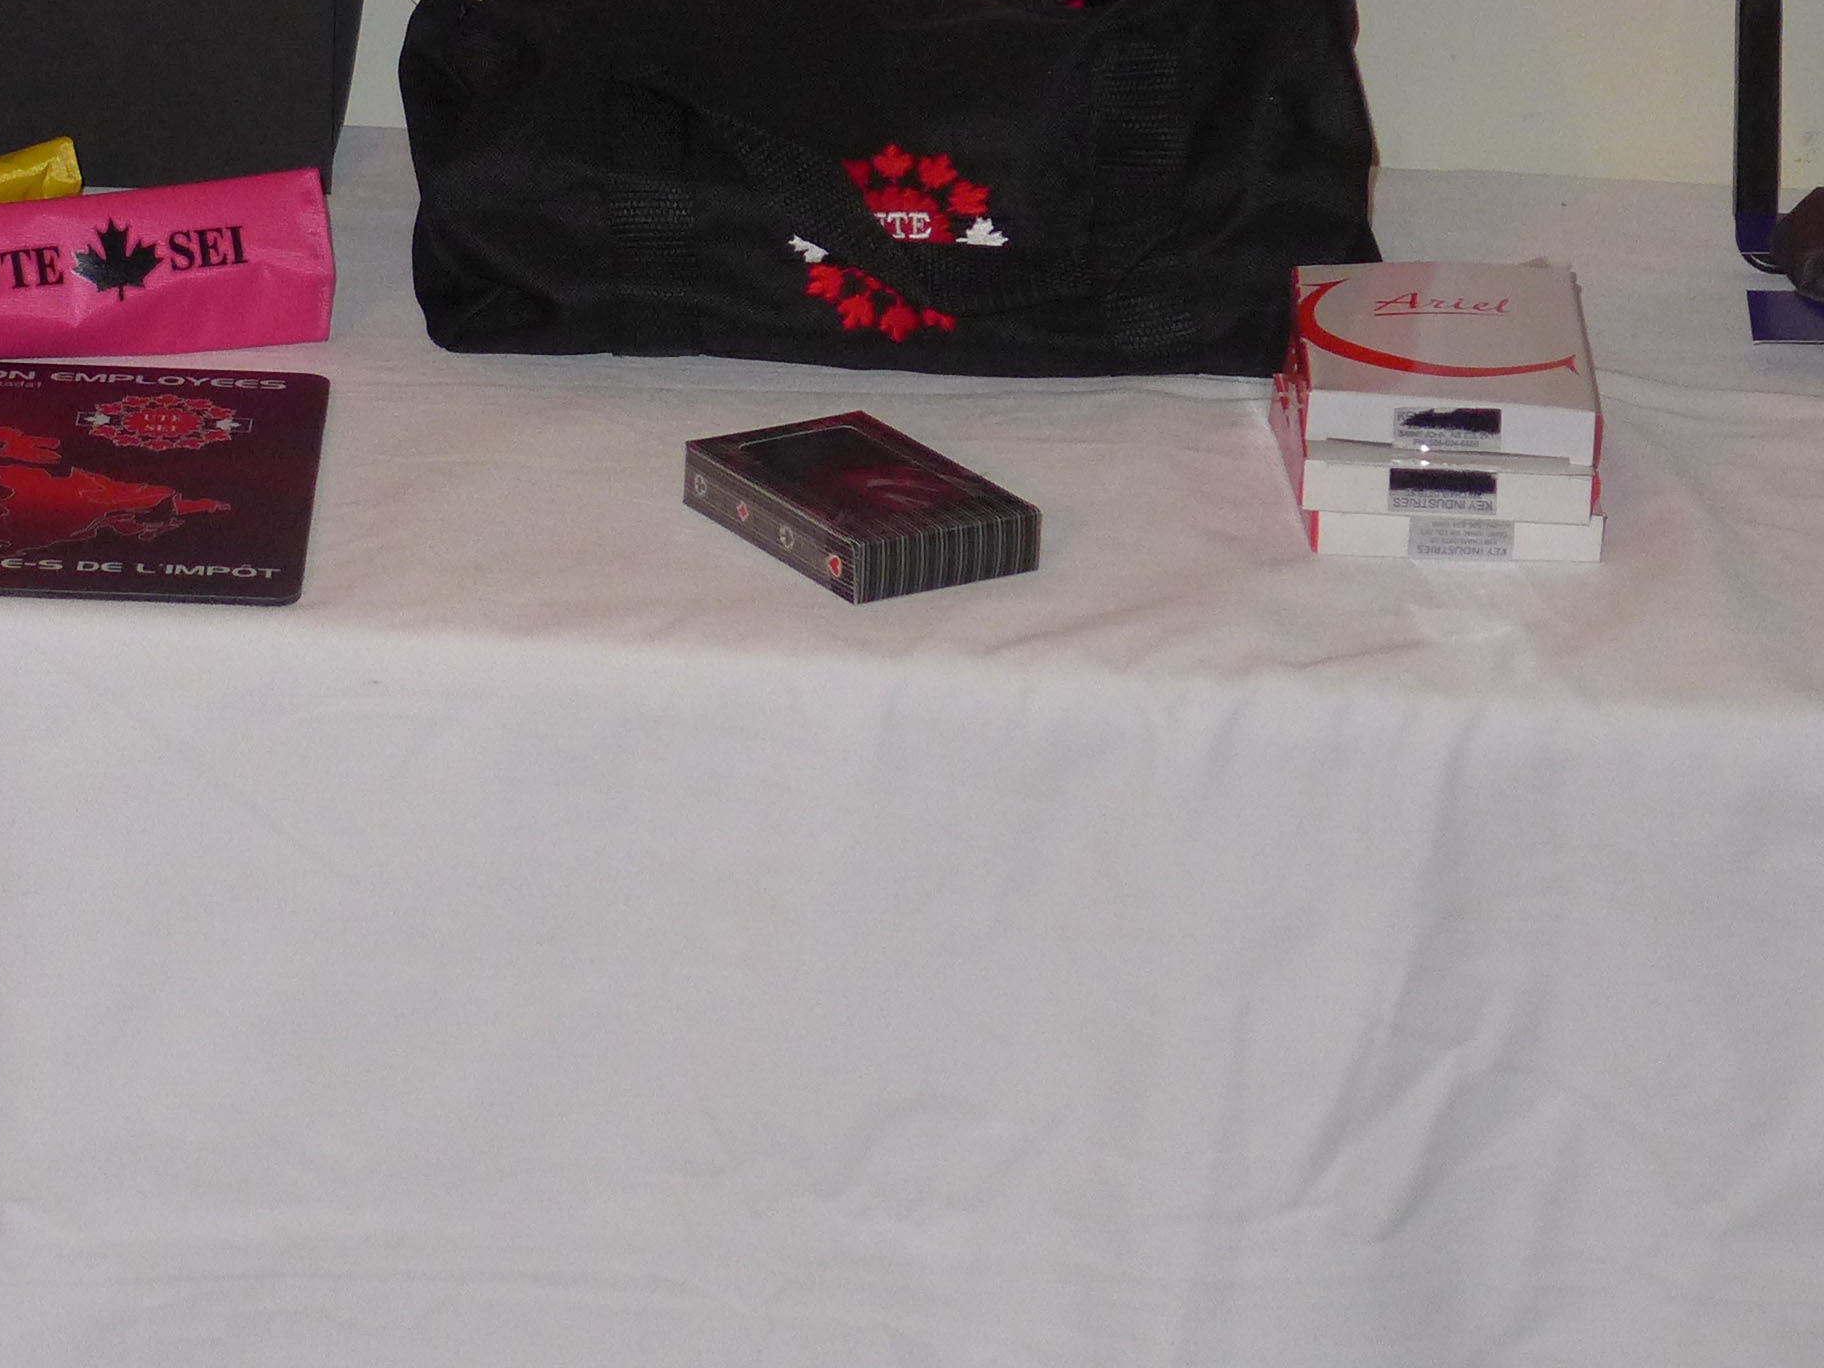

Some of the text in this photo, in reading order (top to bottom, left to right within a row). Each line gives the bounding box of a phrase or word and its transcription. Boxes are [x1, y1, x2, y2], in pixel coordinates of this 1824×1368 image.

[168, 226, 249, 271] SEI
[1375, 292, 1511, 312] Ariel
[51, 371, 288, 391] EMPLOYEES
[1393, 497, 1494, 512] KEY INDUSTRIES
[76, 560, 124, 572] DE
[136, 562, 282, 579] L'IMPÔT
